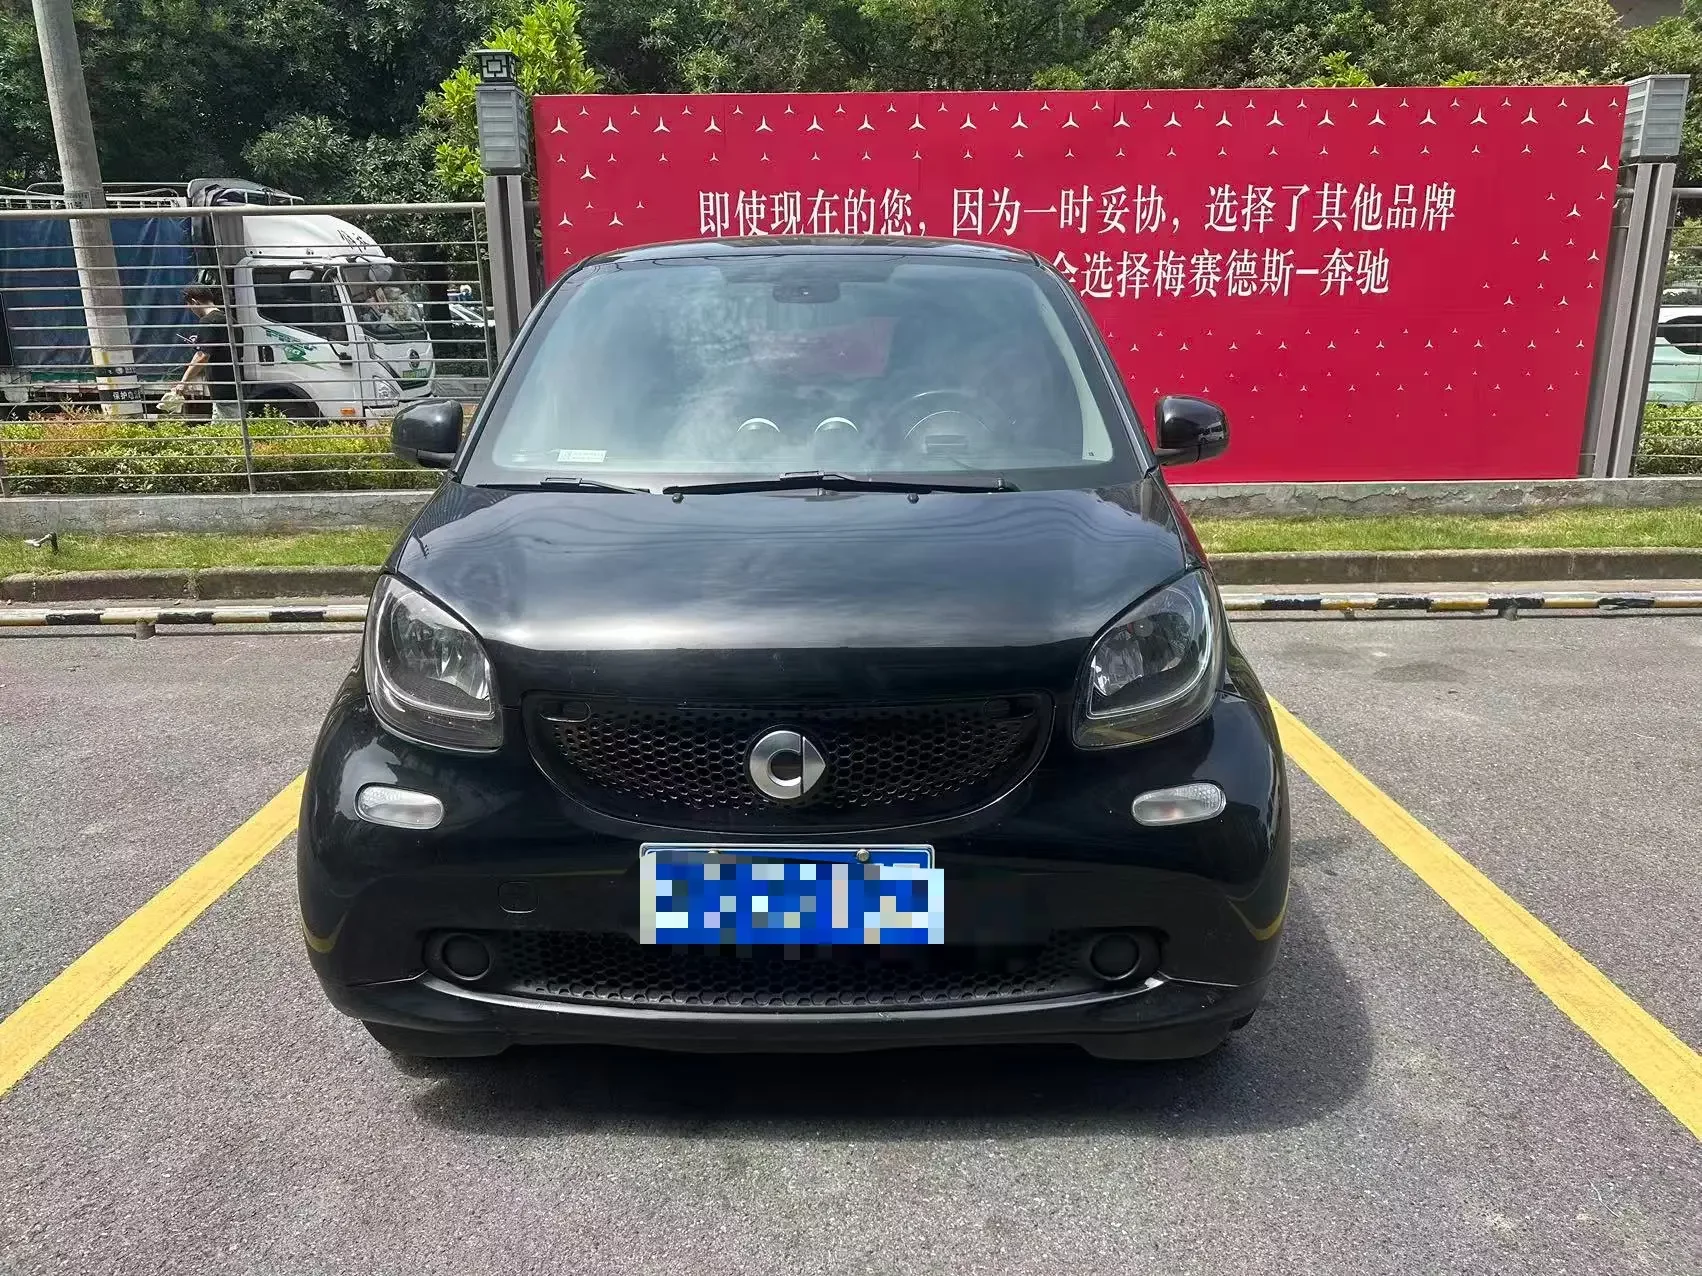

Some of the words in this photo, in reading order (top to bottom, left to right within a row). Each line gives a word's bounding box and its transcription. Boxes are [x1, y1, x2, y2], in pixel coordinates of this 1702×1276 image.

[699, 182, 1456, 237] 即使现在的您，因为一时妥协，选择了其他品牌
